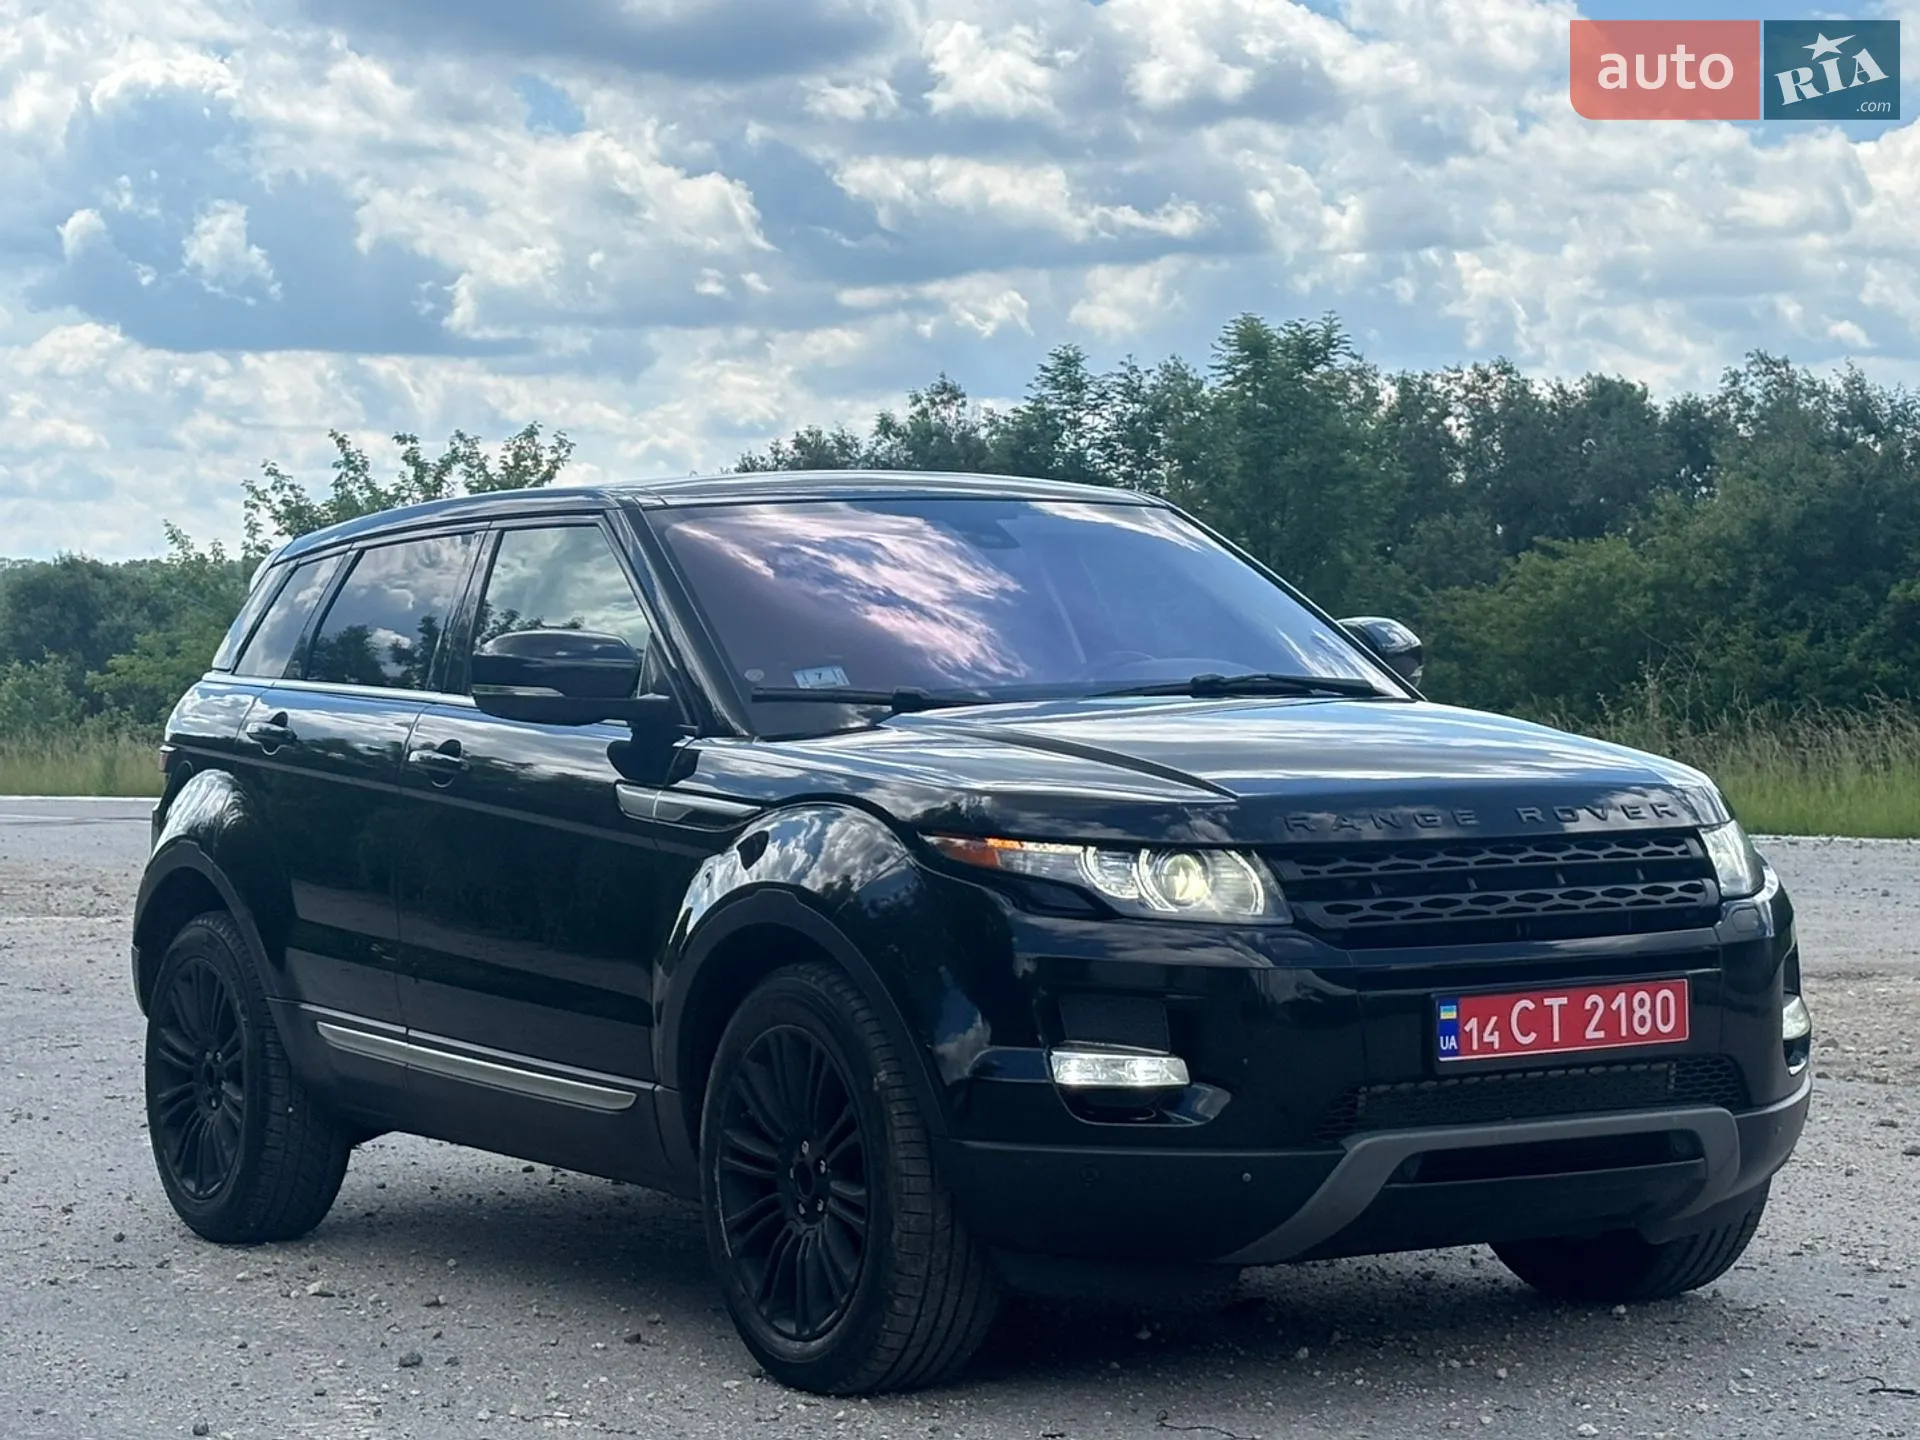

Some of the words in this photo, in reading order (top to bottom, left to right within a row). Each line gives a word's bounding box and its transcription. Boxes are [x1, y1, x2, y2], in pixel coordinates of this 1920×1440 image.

[1283, 808, 1480, 834] RANGE
[1517, 802, 1679, 824] ROVER
[1463, 1015, 1500, 1051] 14
[1510, 996, 1568, 1045] CT
[1584, 988, 1676, 1040] 2180
[1439, 1034, 1458, 1051] UA
